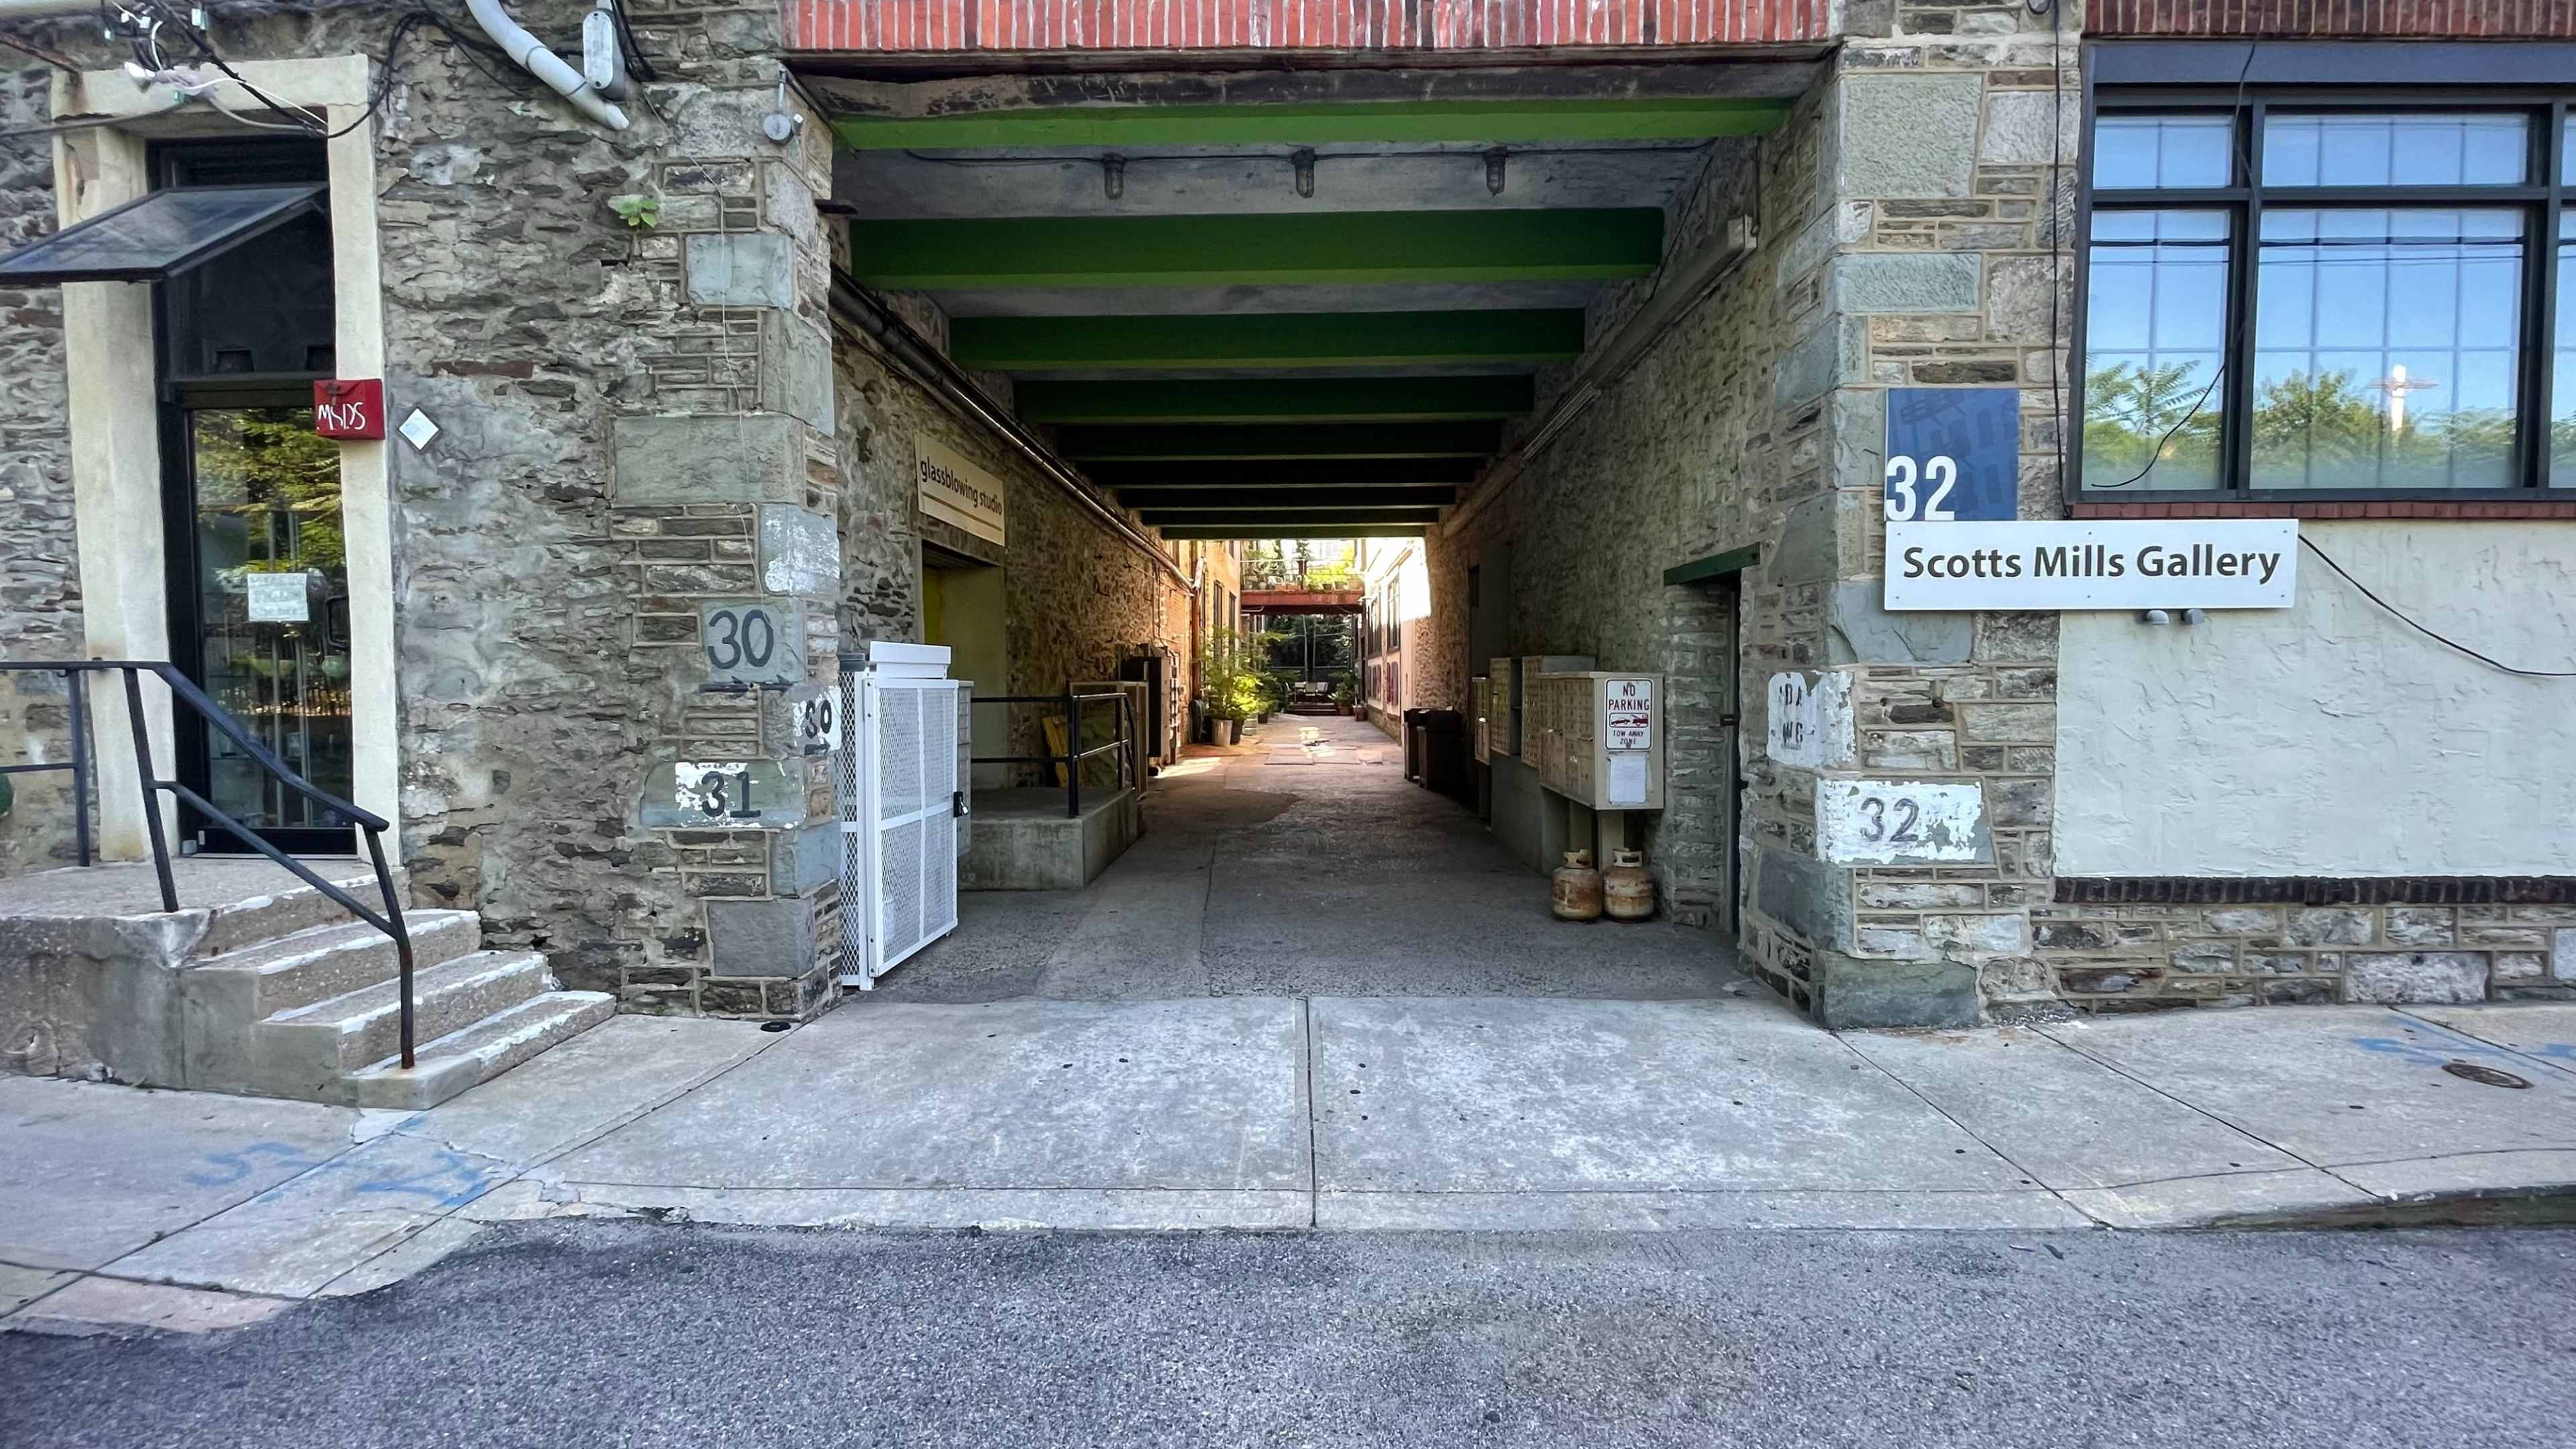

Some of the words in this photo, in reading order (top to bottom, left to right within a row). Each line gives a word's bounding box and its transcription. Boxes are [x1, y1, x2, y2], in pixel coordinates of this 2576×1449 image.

[317, 401, 366, 431] MSDS
[920, 455, 979, 508] glassblowing
[979, 490, 1003, 516] studio
[1885, 455, 1957, 521] 32
[1902, 546, 2022, 578] Scotts
[2033, 544, 2126, 578] Mills
[2136, 543, 2281, 586] Gallery
[707, 608, 774, 669] 30
[1609, 698, 1650, 711] PARKING
[1623, 684, 1636, 697] NO
[805, 699, 832, 739] 30
[1613, 730, 1626, 738] TOW
[1629, 730, 1644, 738] AWAY
[701, 770, 761, 818] 31
[1860, 796, 1920, 843] 32
